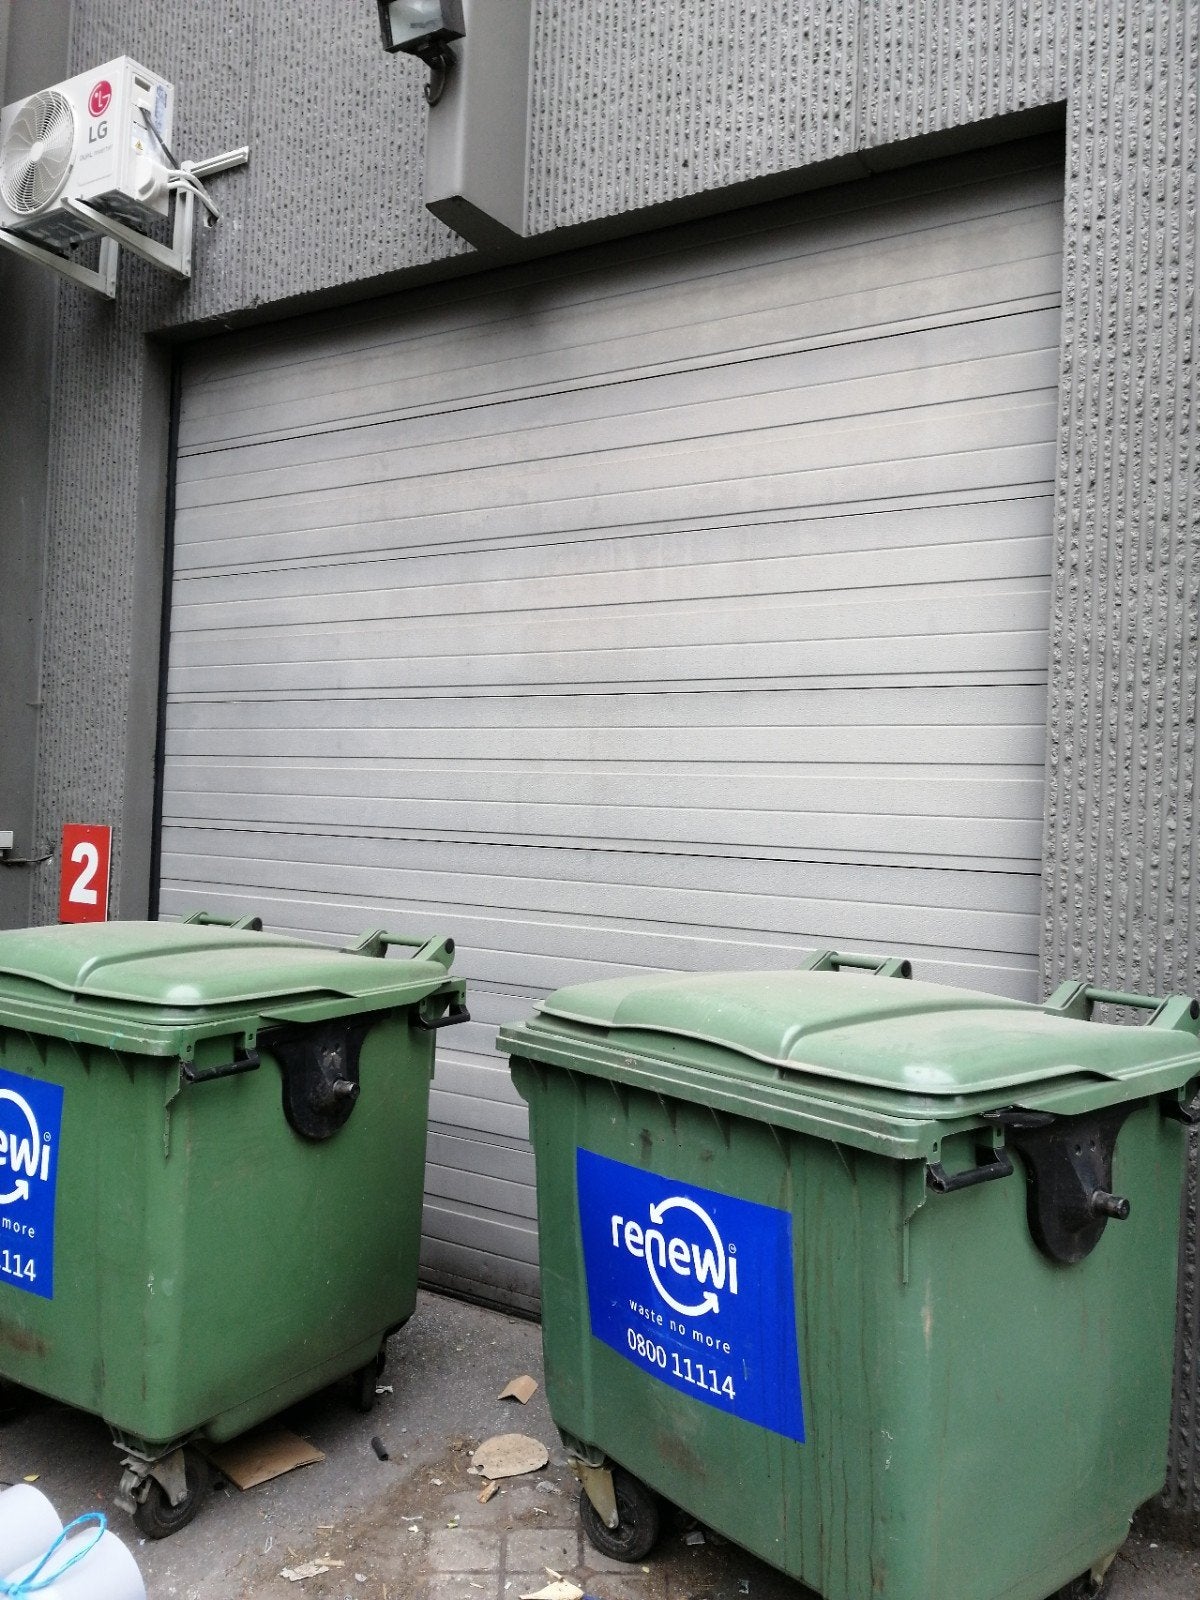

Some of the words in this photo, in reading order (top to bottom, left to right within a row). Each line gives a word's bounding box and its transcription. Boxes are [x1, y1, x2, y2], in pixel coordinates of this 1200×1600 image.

[89, 121, 108, 144] LG
[68, 842, 99, 904] 2
[2, 1217, 35, 1238] more
[611, 1214, 738, 1295] renewi
[629, 1300, 663, 1326] waste
[669, 1319, 686, 1336] no
[692, 1328, 731, 1354] more
[627, 1328, 667, 1368] 0800
[671, 1352, 736, 1400] 11114
